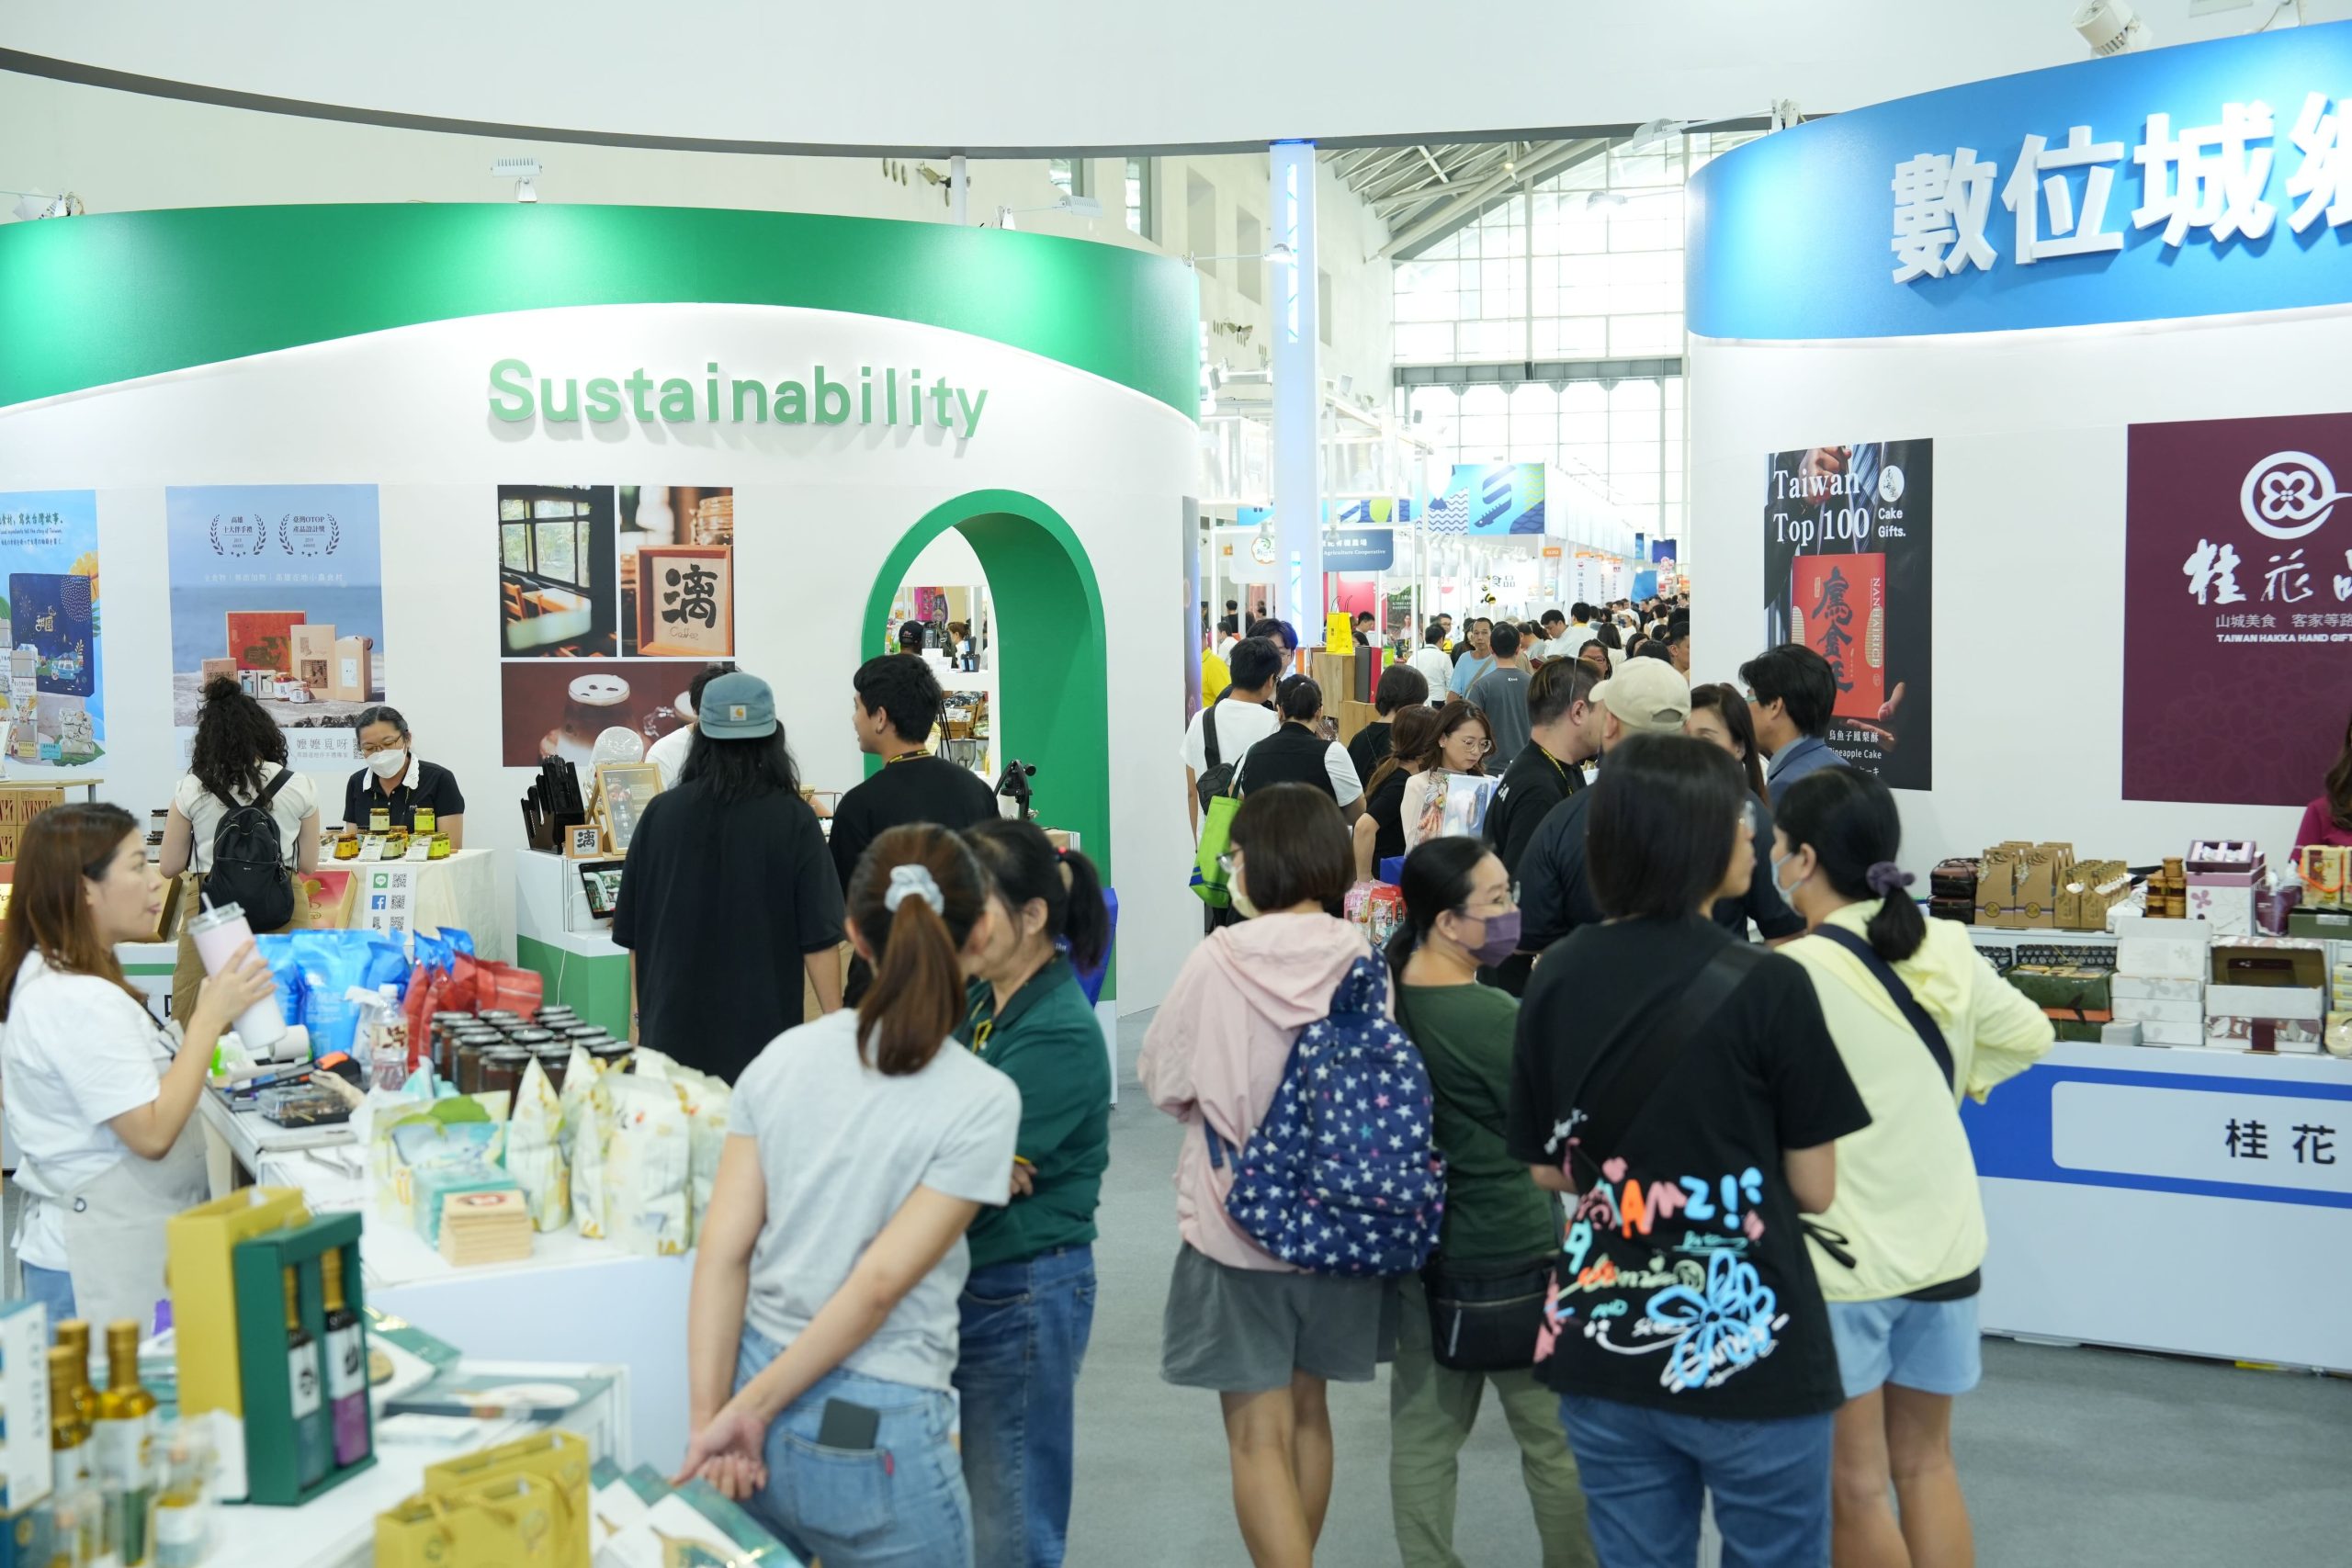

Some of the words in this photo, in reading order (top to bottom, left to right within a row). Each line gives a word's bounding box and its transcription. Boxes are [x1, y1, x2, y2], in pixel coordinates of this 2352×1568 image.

[489, 357, 989, 438] Sustainability
[1773, 468, 1860, 500] Taiwan
[1878, 508, 1904, 520] Cake
[1773, 513, 1815, 547] Top
[1823, 507, 1871, 540] 100
[1878, 525, 1906, 538] Gifts.
[2215, 614, 2277, 628] 山城美食
[2217, 634, 2258, 643] TAIWAN
[2259, 634, 2296, 643] HAKKA
[2298, 634, 2329, 643] HAND
[1863, 749, 1883, 760] Cake
